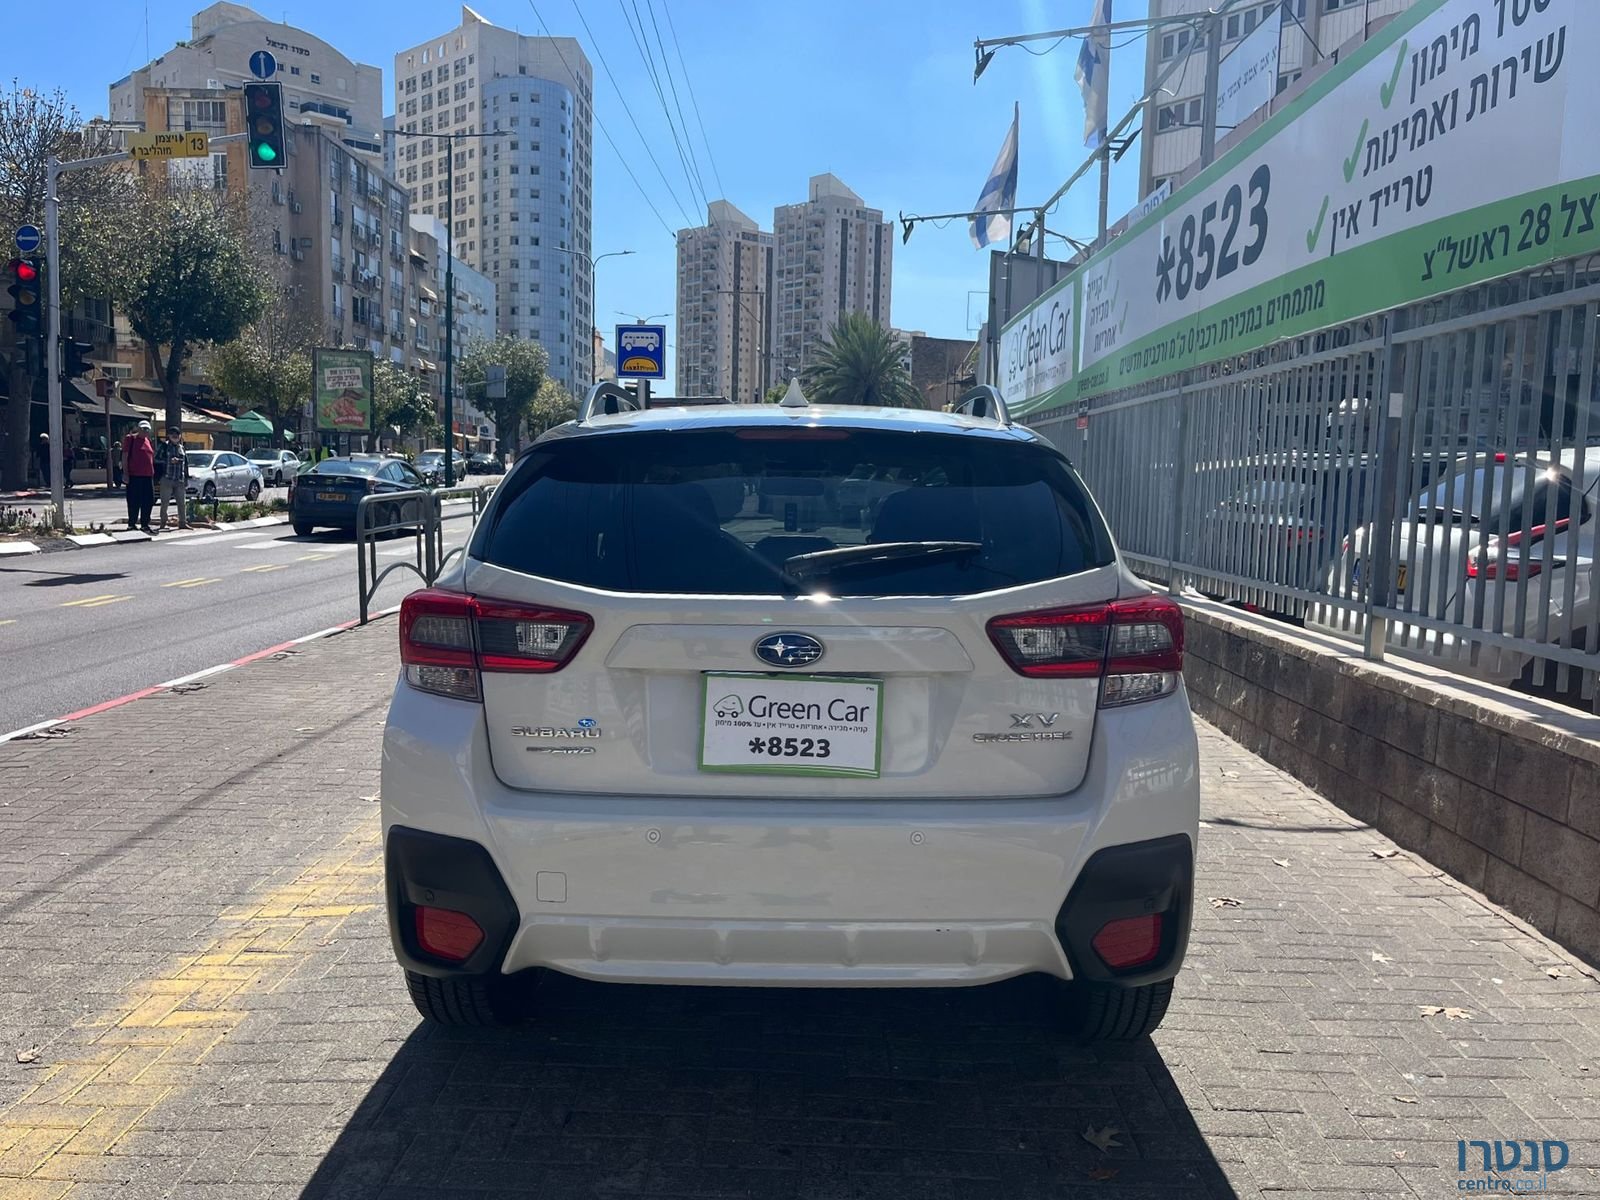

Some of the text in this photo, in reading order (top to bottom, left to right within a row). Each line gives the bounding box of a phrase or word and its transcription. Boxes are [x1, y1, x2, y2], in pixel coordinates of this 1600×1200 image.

[1410, 13, 1481, 104] מימון
[1362, 25, 1567, 178] שירות ואמינות
[137, 144, 172, 156] מוהליבר
[155, 134, 178, 146] ויצמן
[190, 138, 204, 151] 13
[1330, 164, 1433, 257] טרייד אין
[1560, 190, 1600, 238] צל
[1517, 203, 1552, 252] 28
[1266, 279, 1325, 326] מתמחים
[1049, 301, 1070, 356] Car
[1196, 323, 1217, 351] רכבי
[1219, 304, 1262, 344] במכירת
[1119, 351, 1142, 376] חדשים
[1143, 341, 1168, 368] ורכבים
[748, 695, 870, 723] Green Car
[1009, 712, 1060, 728] XV
[511, 725, 602, 738] SUBARU
